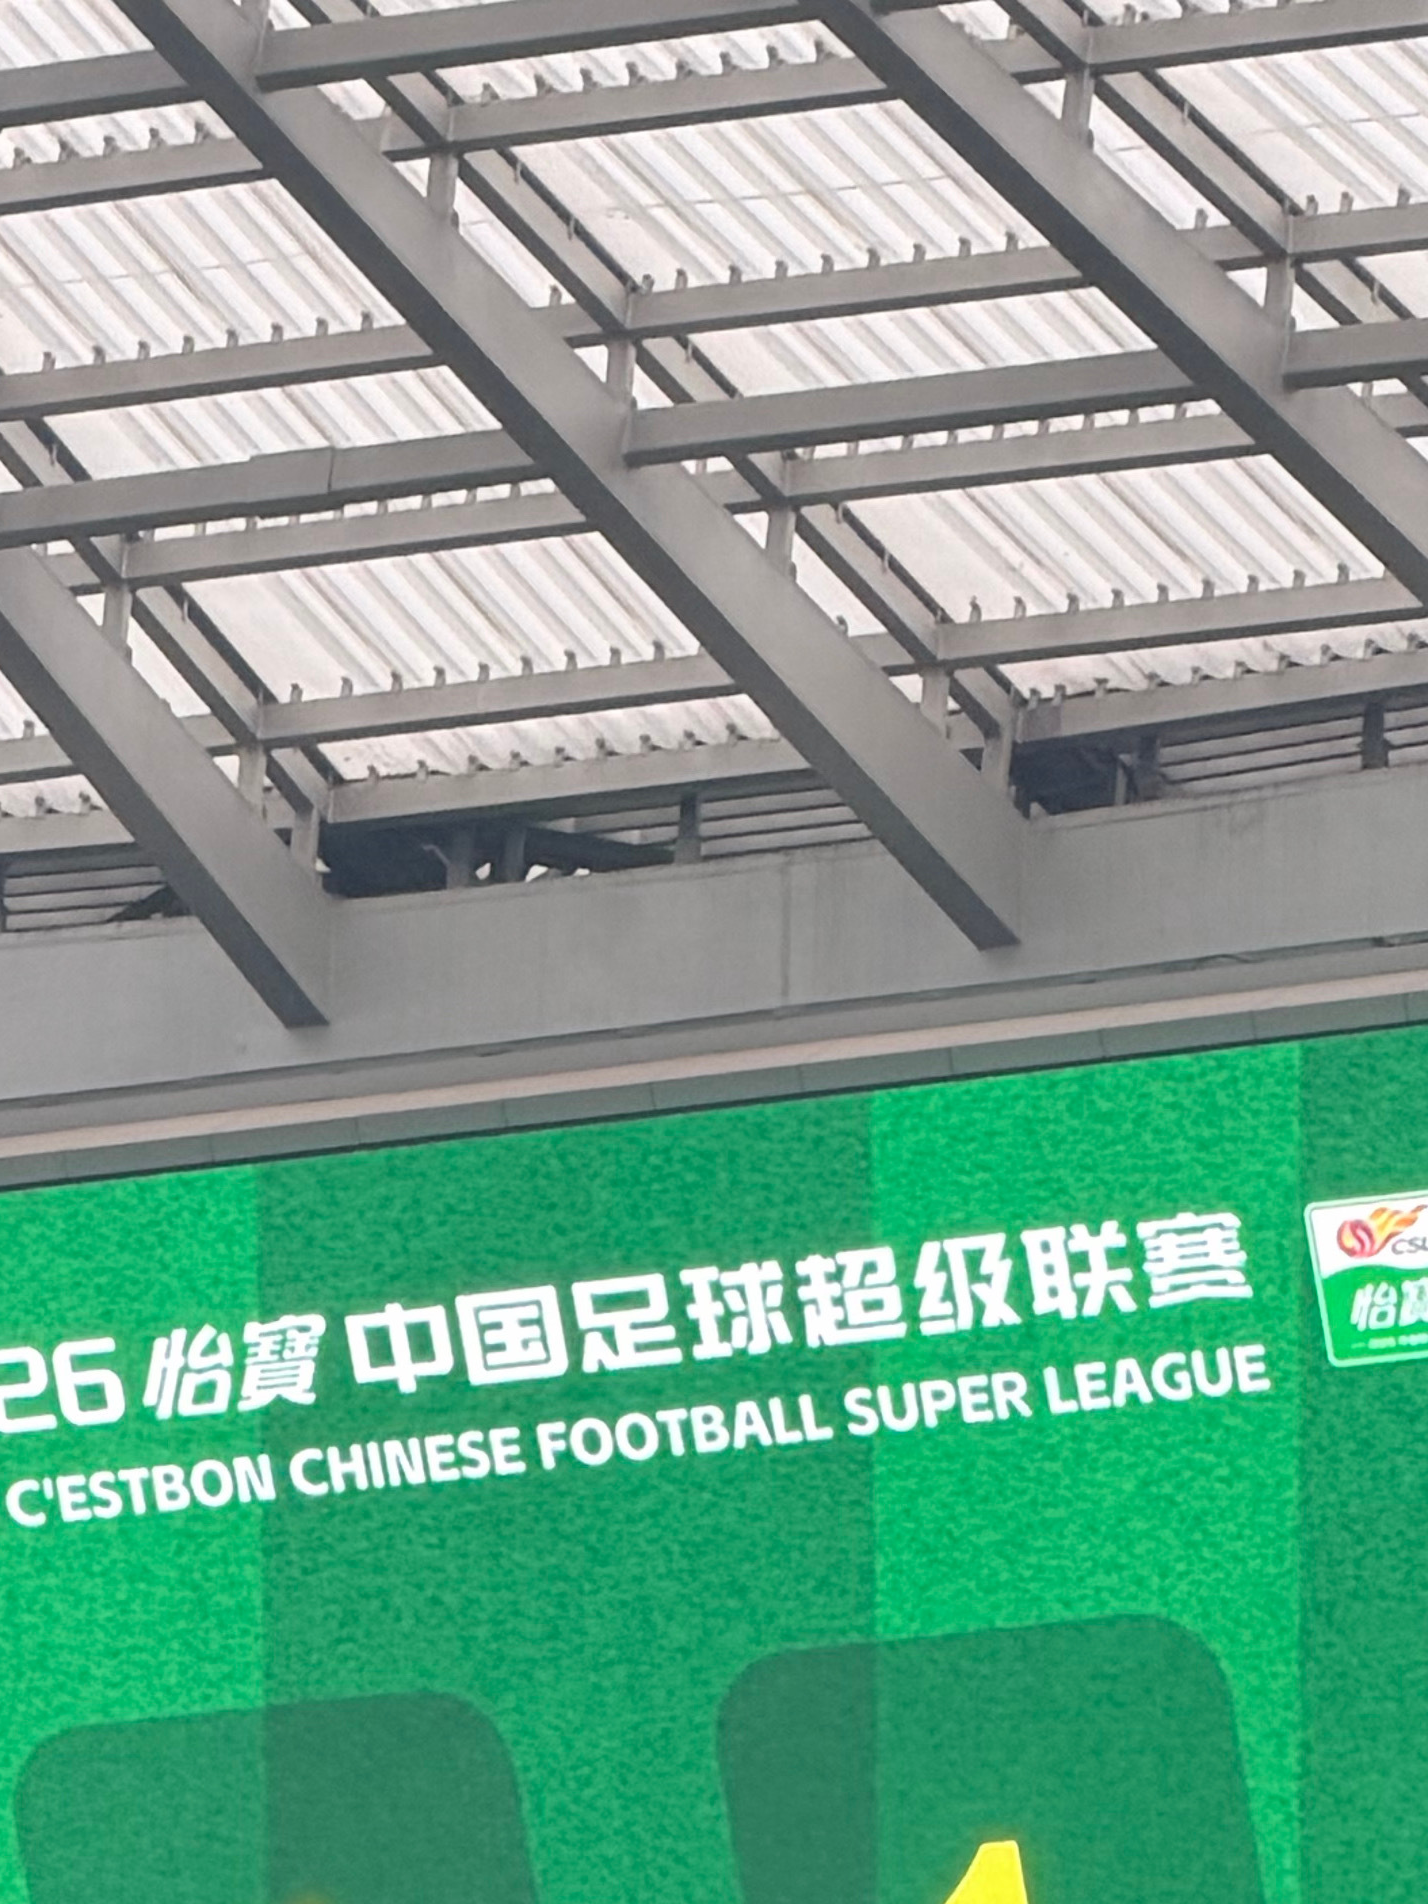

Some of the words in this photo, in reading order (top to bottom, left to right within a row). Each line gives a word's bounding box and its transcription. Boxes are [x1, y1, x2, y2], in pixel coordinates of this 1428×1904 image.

[4, 1452, 277, 1527] C'ESTBON
[288, 1425, 528, 1497] CHINESE
[535, 1393, 835, 1471] FOOTBALL
[843, 1370, 1034, 1436] SUPER
[1042, 1342, 1272, 1415] LEAGUE
